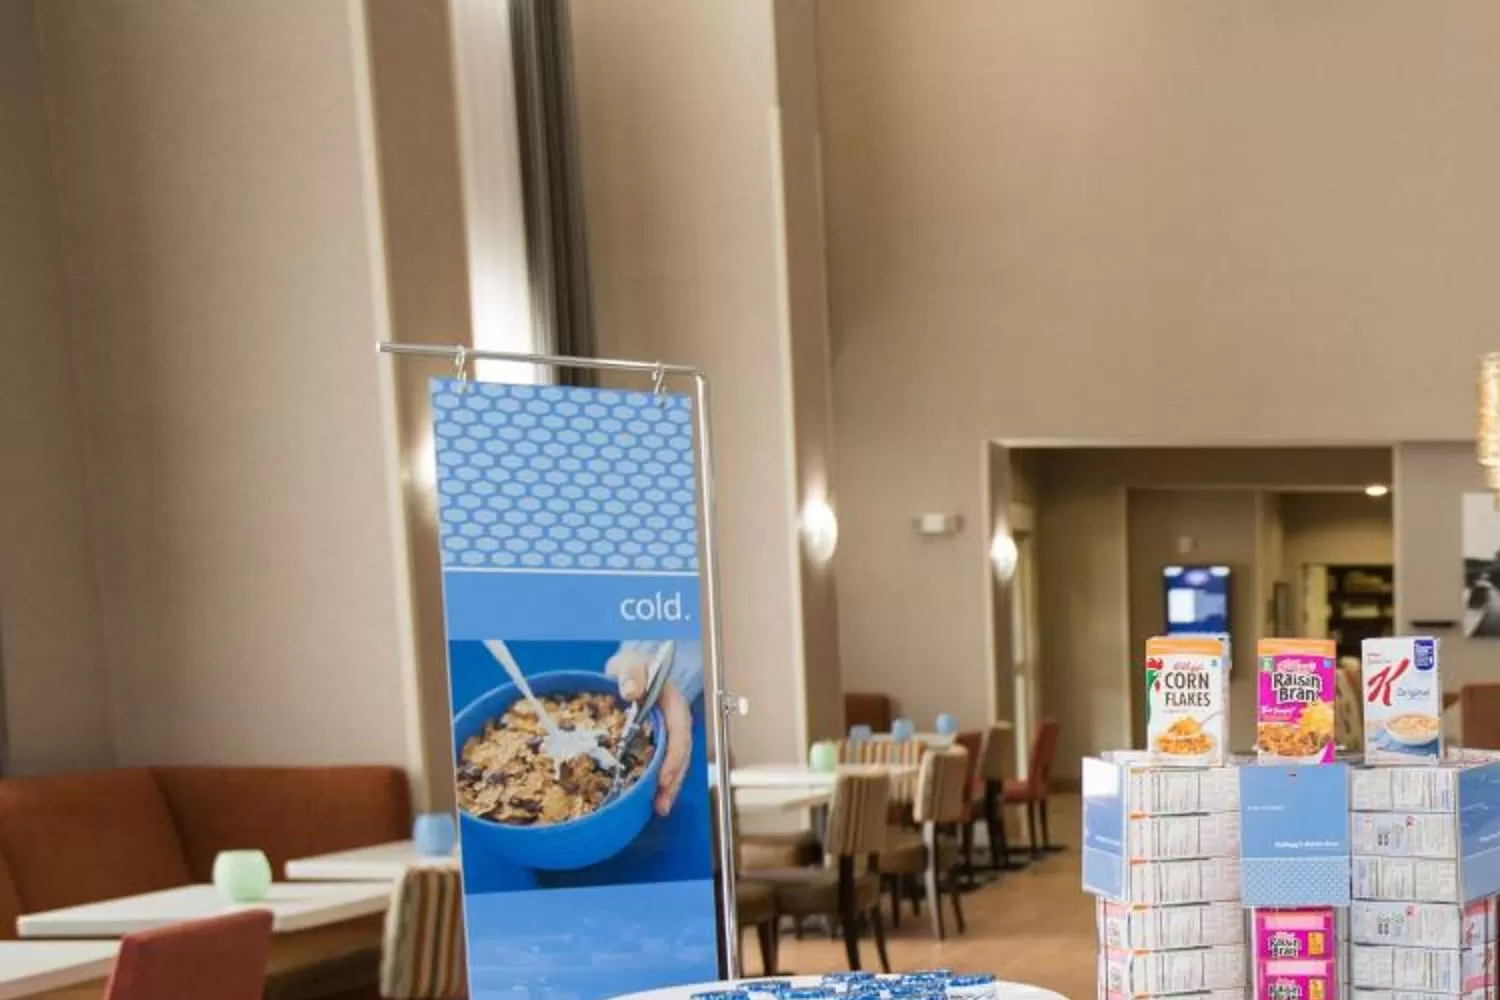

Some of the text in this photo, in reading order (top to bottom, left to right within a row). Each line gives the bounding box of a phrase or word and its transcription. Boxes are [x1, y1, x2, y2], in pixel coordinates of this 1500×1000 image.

[620, 591, 691, 621] cold.
[1164, 671, 1210, 690] CORN
[1273, 672, 1321, 689] Raisin
[1164, 691, 1212, 707] FLAKES
[1279, 687, 1317, 702] Bran
